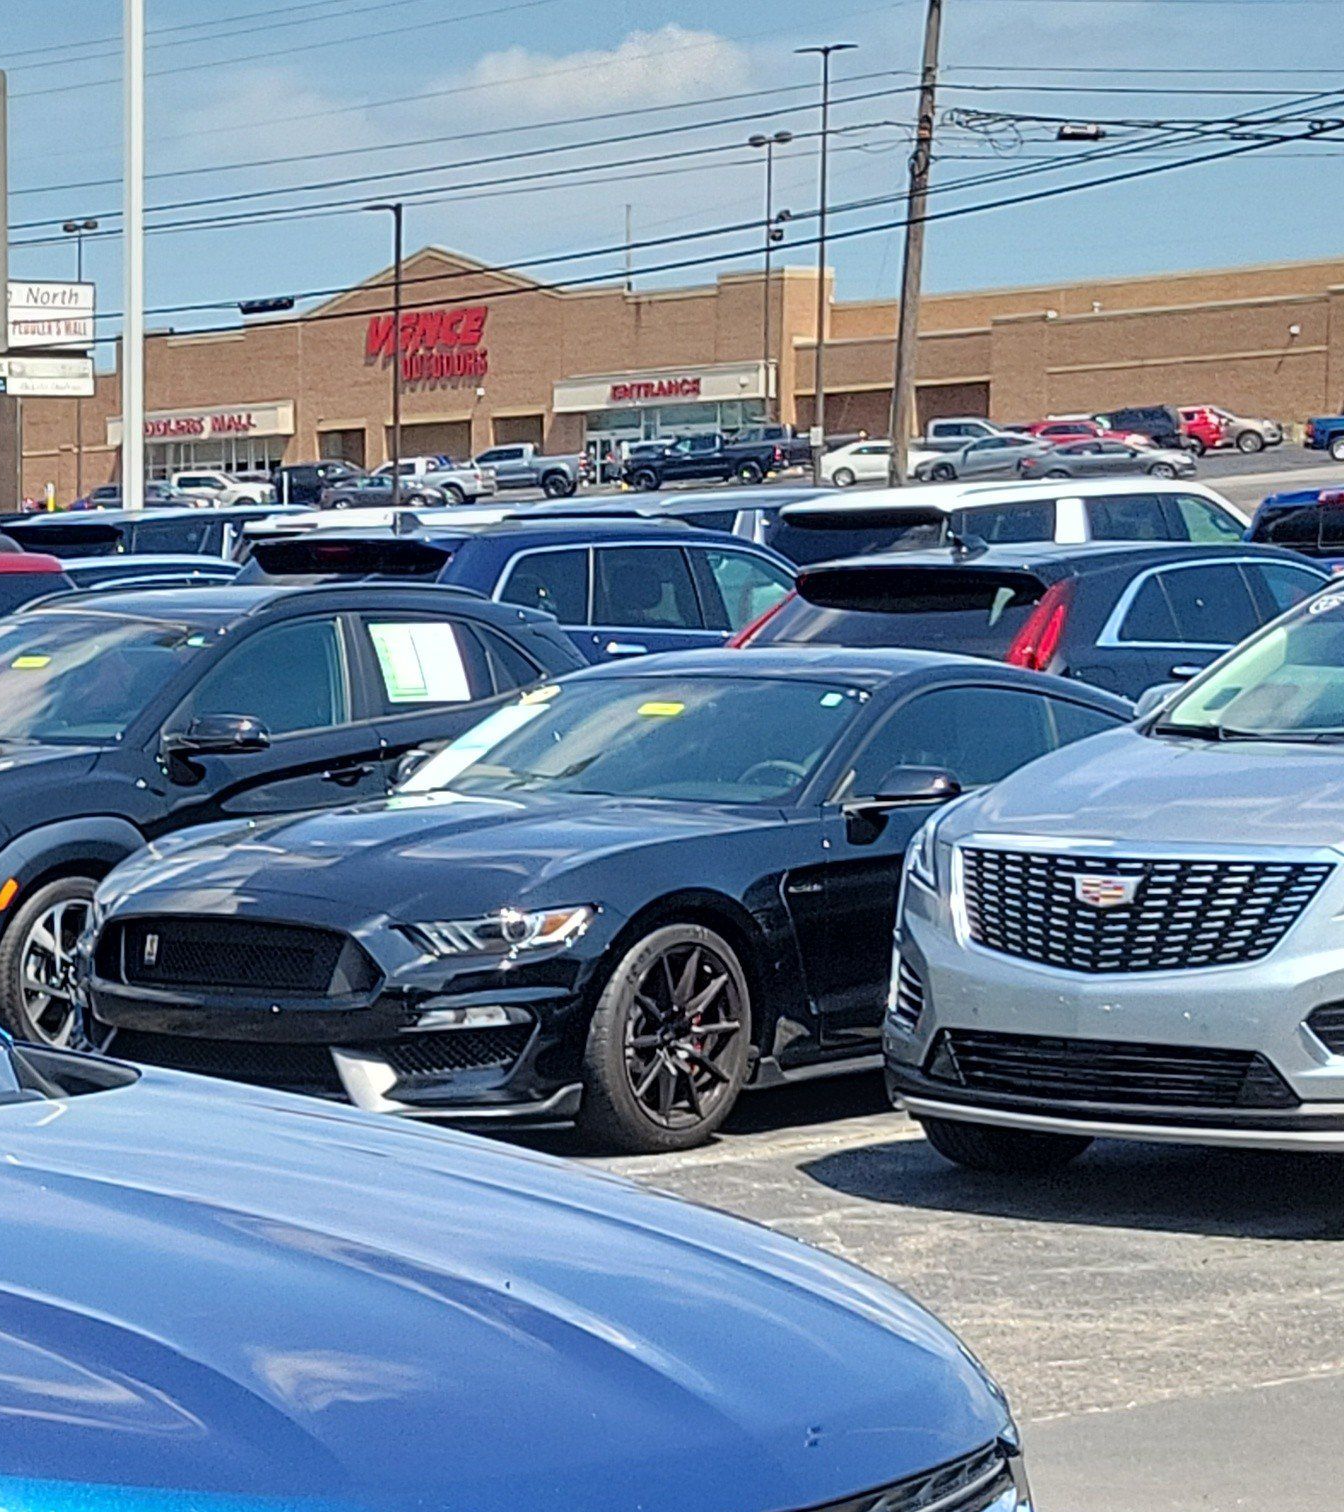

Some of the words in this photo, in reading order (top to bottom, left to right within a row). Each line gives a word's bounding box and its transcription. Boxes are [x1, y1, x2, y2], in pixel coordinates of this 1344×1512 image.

[26, 286, 79, 304] North
[610, 377, 701, 402] ENTRANCE
[211, 412, 257, 433] MALL
